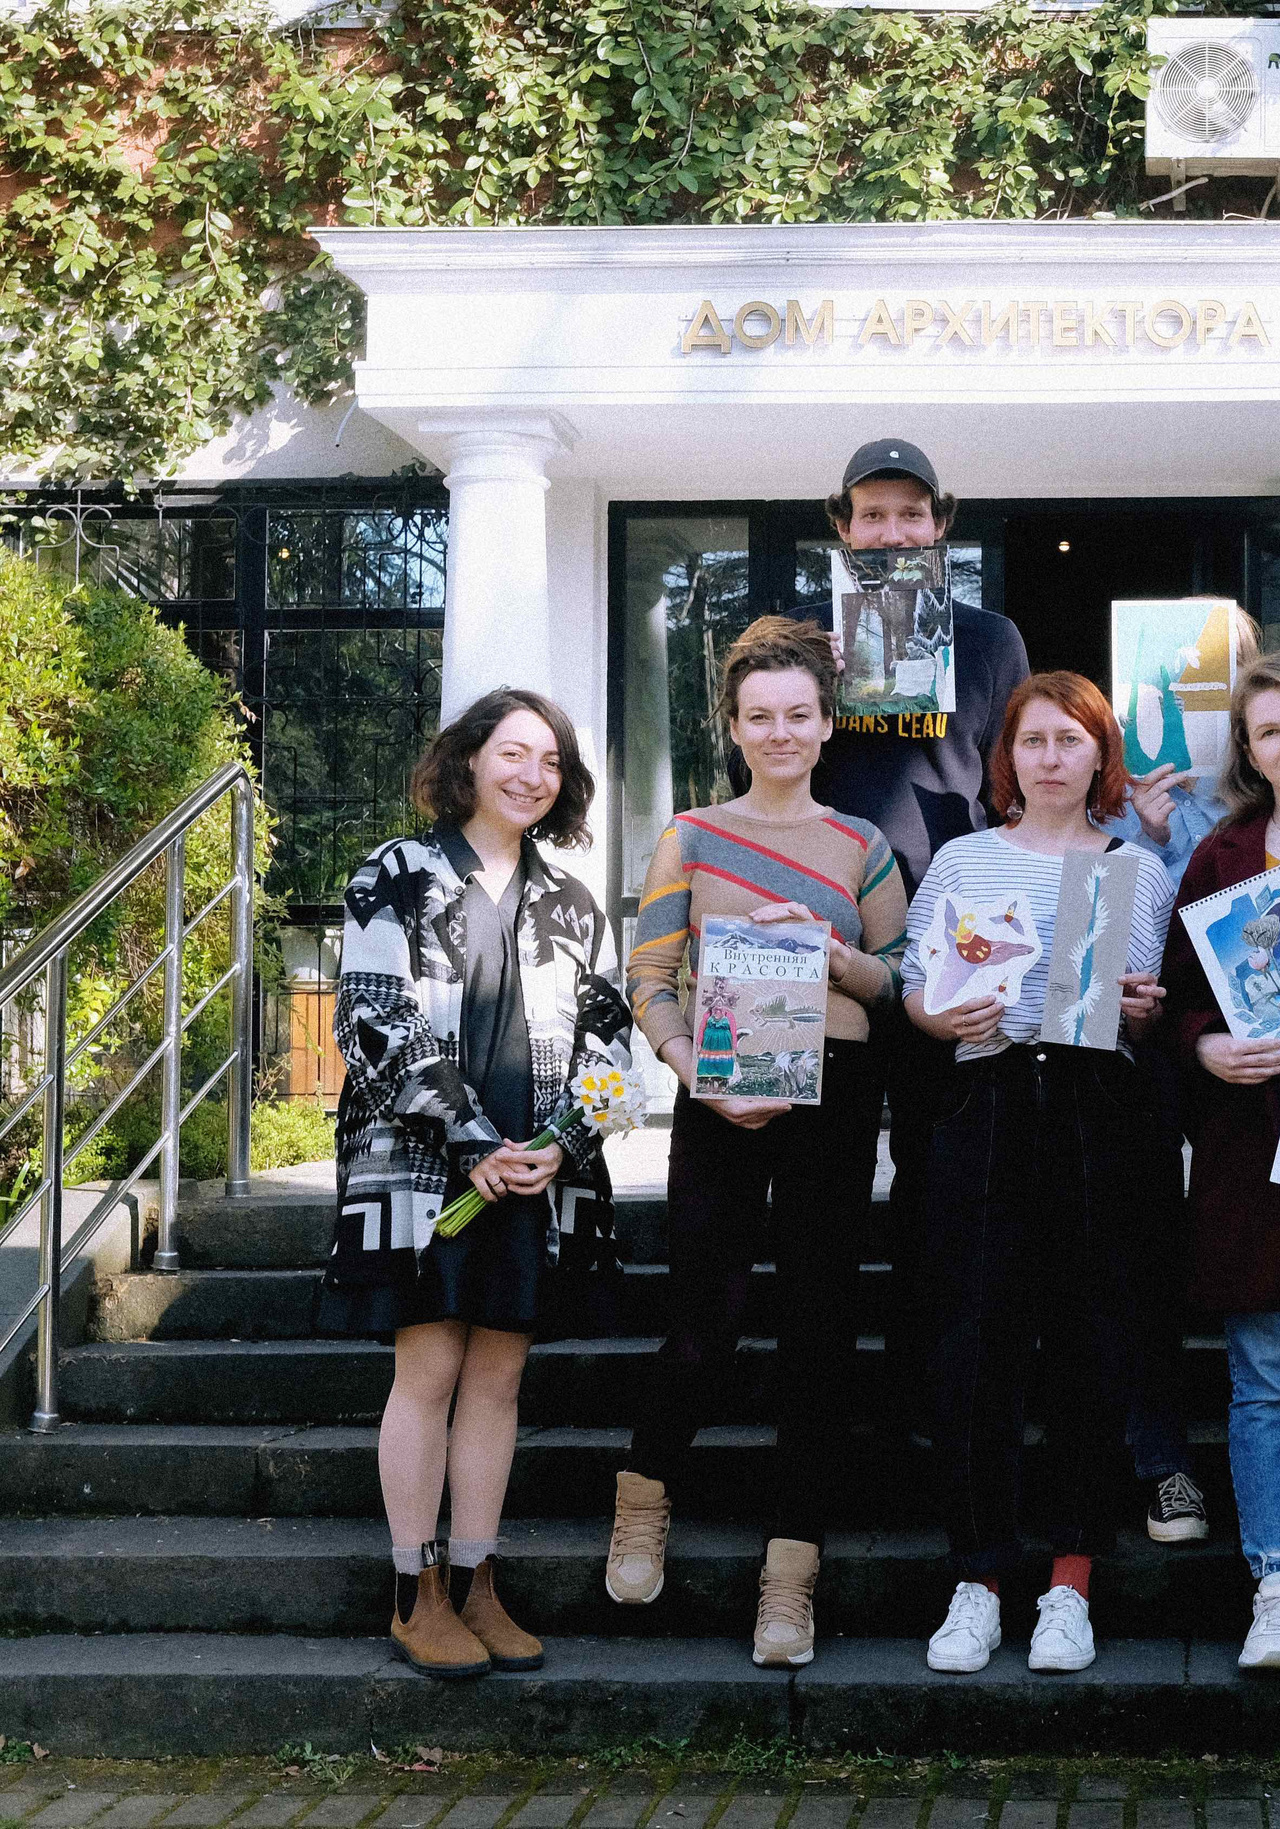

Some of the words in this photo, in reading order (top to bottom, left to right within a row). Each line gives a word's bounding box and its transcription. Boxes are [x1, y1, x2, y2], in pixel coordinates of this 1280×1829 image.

[681, 299, 834, 355] ДОМ
[859, 299, 1272, 349] АРХИТЕКТОРА
[724, 949, 807, 965] Внутренняя
[710, 961, 820, 979] КРАСОТА
